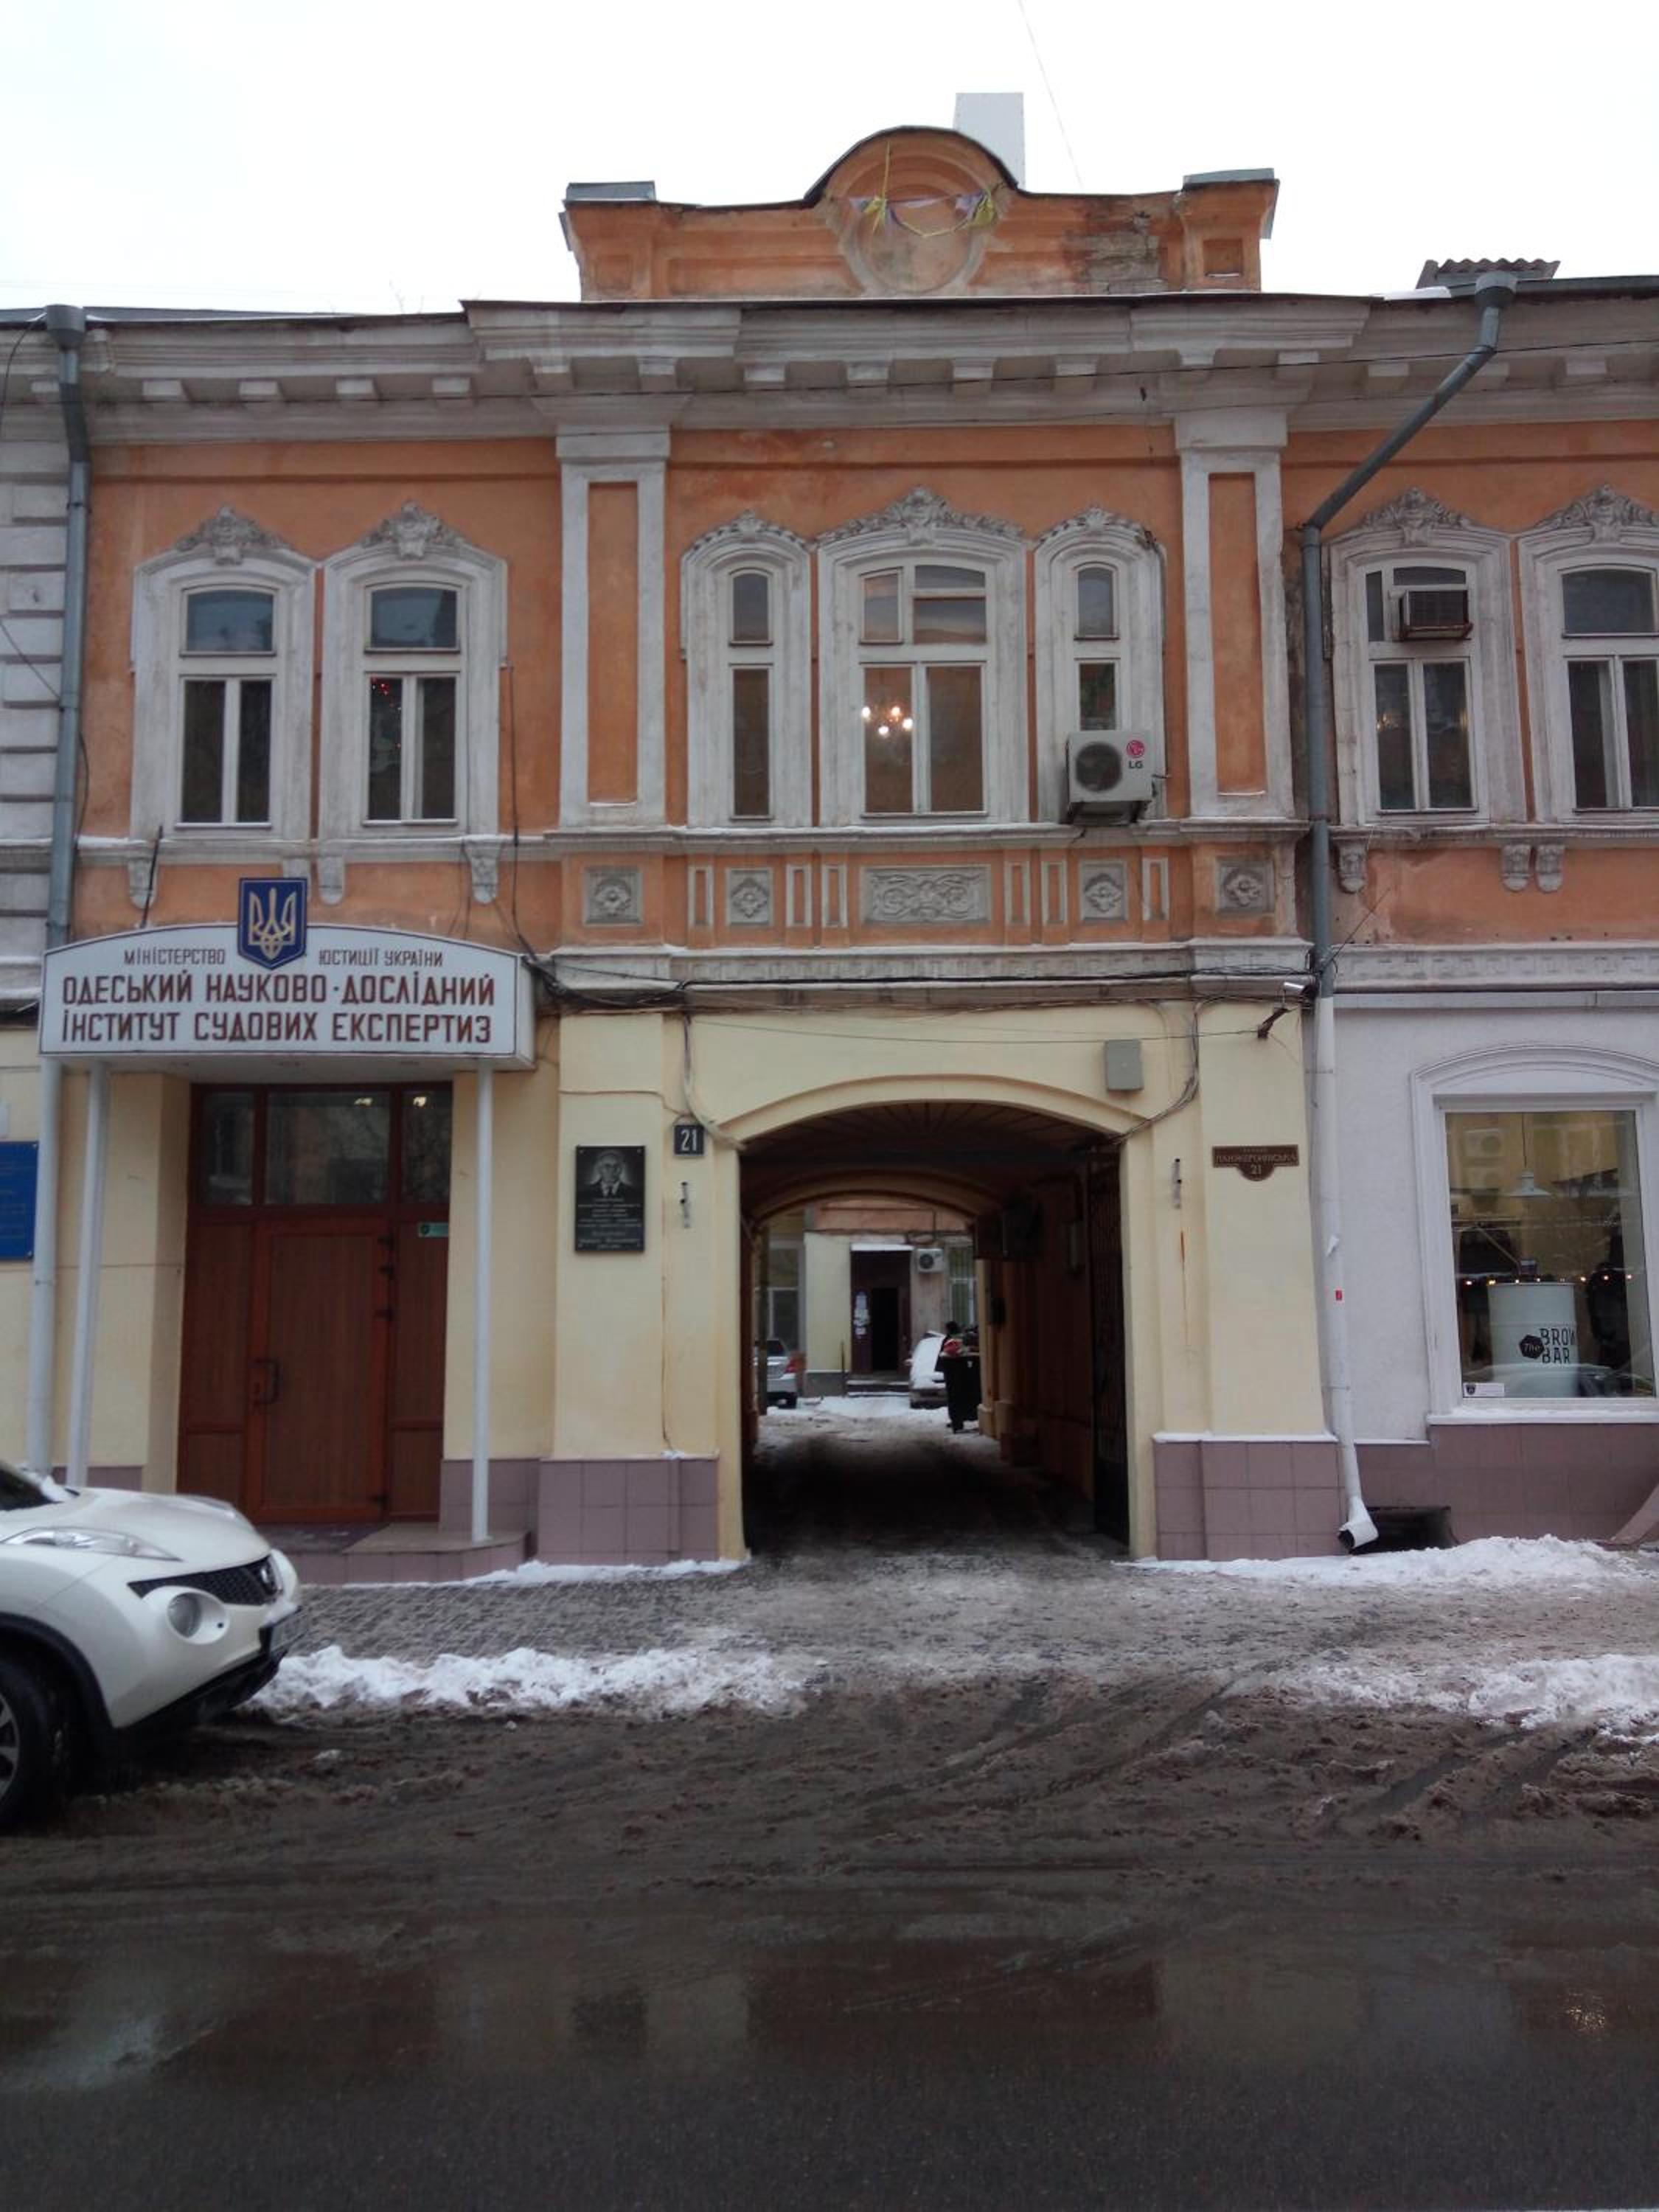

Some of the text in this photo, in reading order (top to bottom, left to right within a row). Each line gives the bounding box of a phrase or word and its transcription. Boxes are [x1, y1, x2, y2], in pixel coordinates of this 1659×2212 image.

[1128, 761, 1143, 769] LG
[123, 947, 226, 965] МІНІСТЕРСТВО
[383, 948, 443, 967] УКРАЇНИ
[62, 969, 192, 1005] ОДЕСЬКИЙ
[62, 1009, 491, 1044] ІНСТИТУТ СУДОВИХ ЕКСПЕРТИЗ
[680, 1129, 698, 1151] 21
[1250, 1164, 1262, 1175] 21
[1541, 1347, 1571, 1364] BAR
